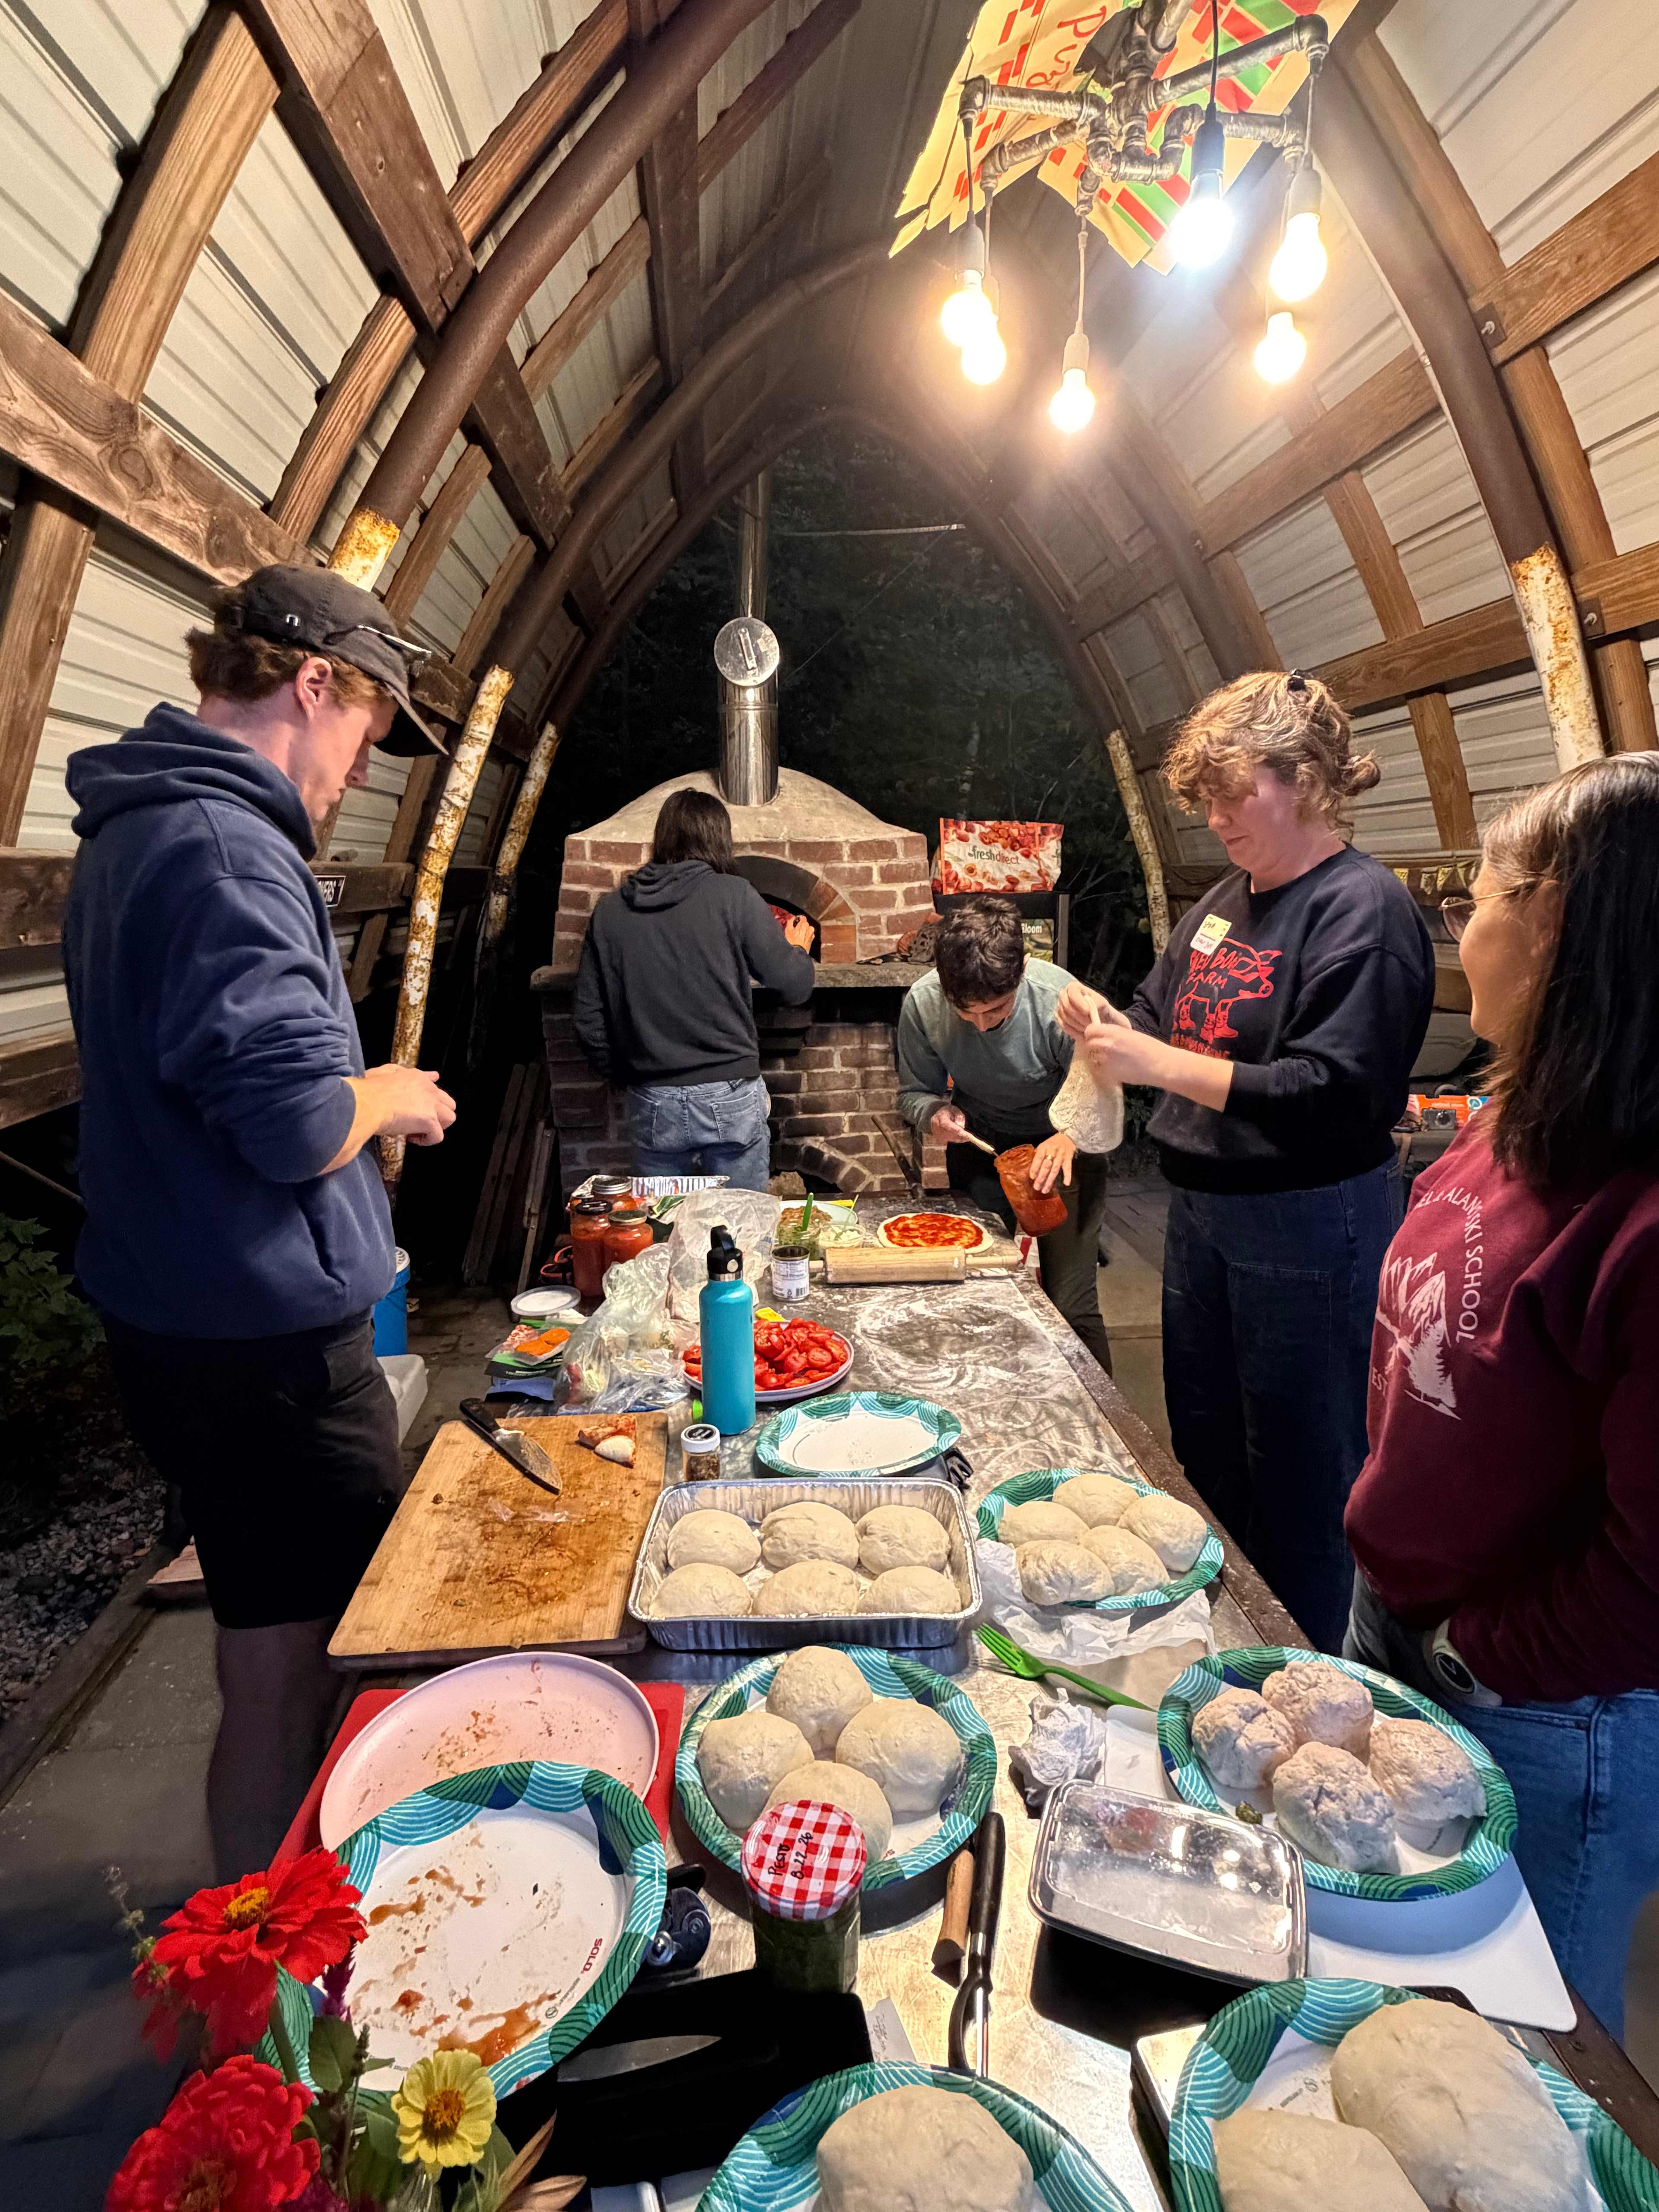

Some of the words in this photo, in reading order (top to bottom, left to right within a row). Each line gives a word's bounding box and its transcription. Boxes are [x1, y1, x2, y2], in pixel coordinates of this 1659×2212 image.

[1185, 971, 1228, 989] FARM
[1455, 1245, 1484, 1343] SCHOOL
[583, 1938, 603, 1972] SOLO
